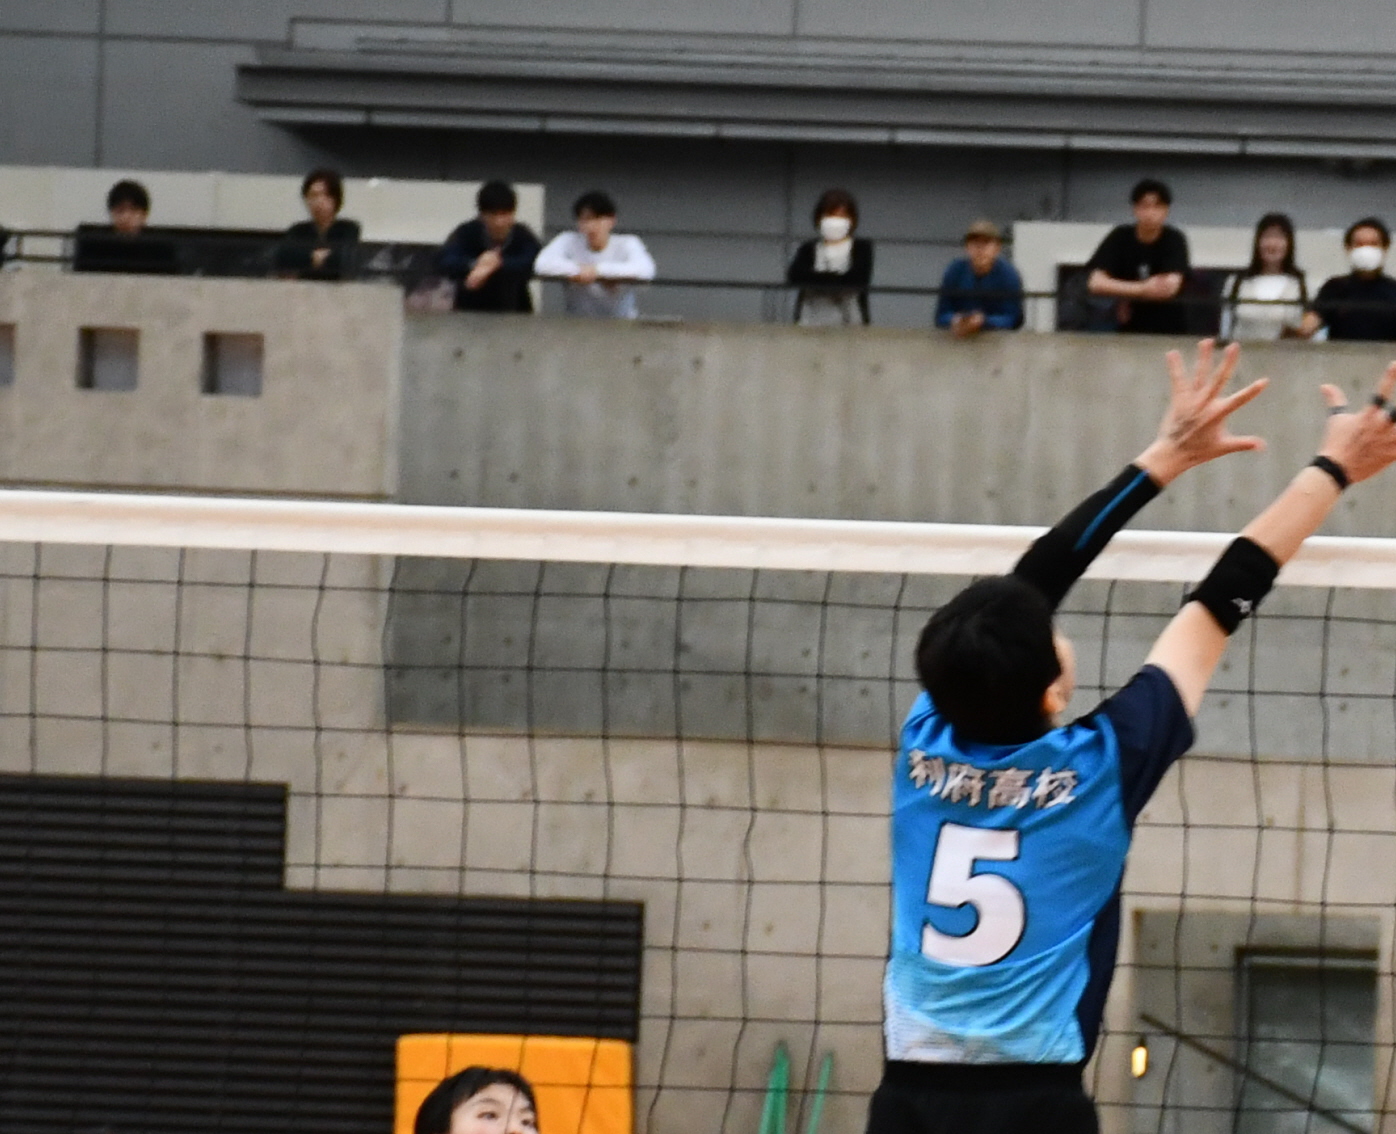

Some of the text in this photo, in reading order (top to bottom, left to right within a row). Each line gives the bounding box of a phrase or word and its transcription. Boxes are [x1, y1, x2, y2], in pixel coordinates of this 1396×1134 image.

[908, 748, 1080, 810] 利府高校
[921, 822, 1027, 968] 5
